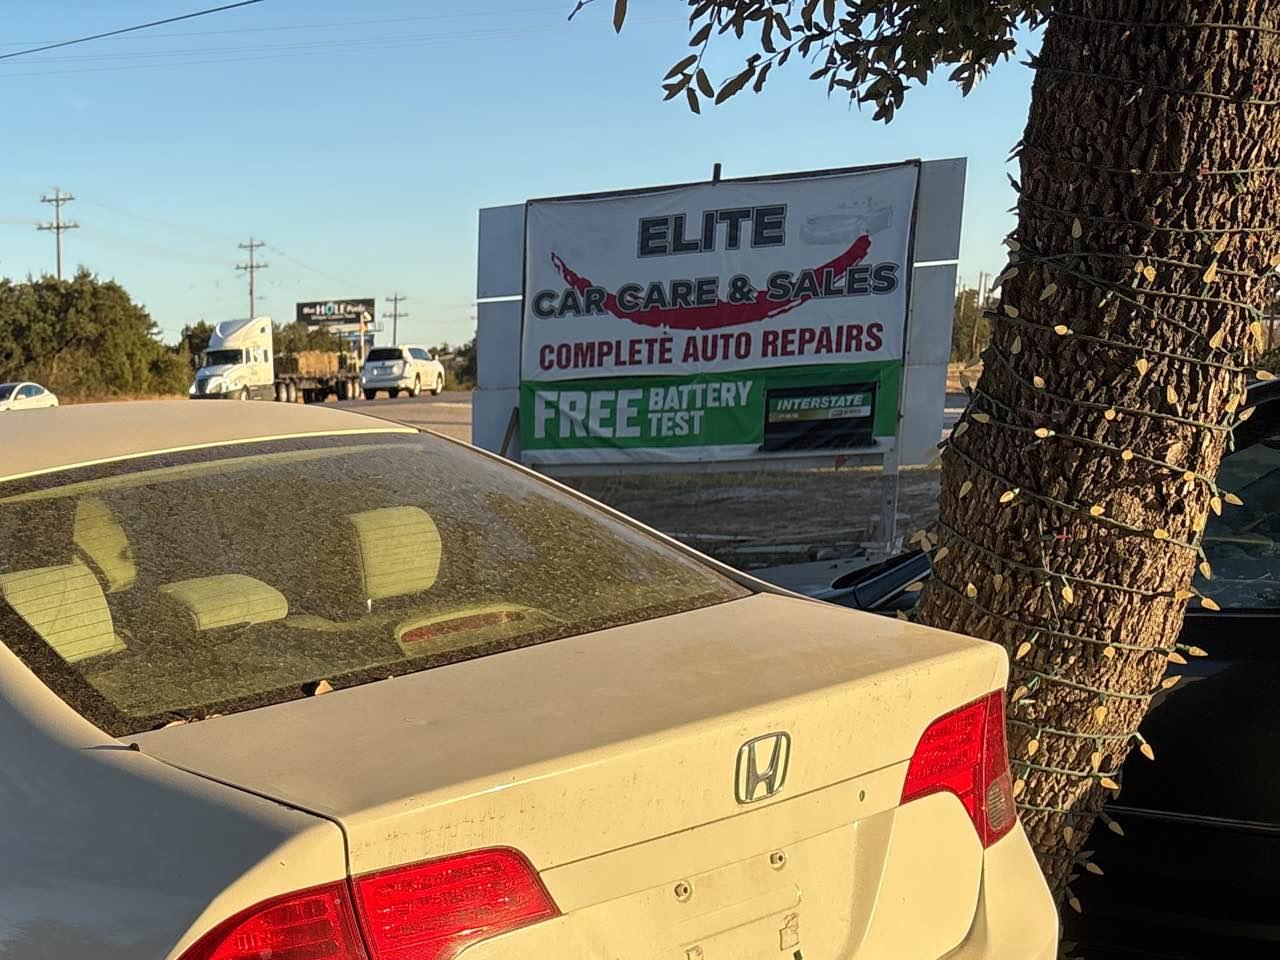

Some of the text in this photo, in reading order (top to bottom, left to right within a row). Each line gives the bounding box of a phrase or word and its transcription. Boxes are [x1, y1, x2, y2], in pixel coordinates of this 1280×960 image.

[637, 204, 787, 258] ELITE
[532, 262, 900, 319] CAR CARE & SALES
[539, 323, 883, 371] COMPLETE AUTO REPAIRS
[534, 380, 753, 439] FREE BATTERY
[648, 410, 705, 437] TEST
[777, 394, 865, 411] INTERSTATE
